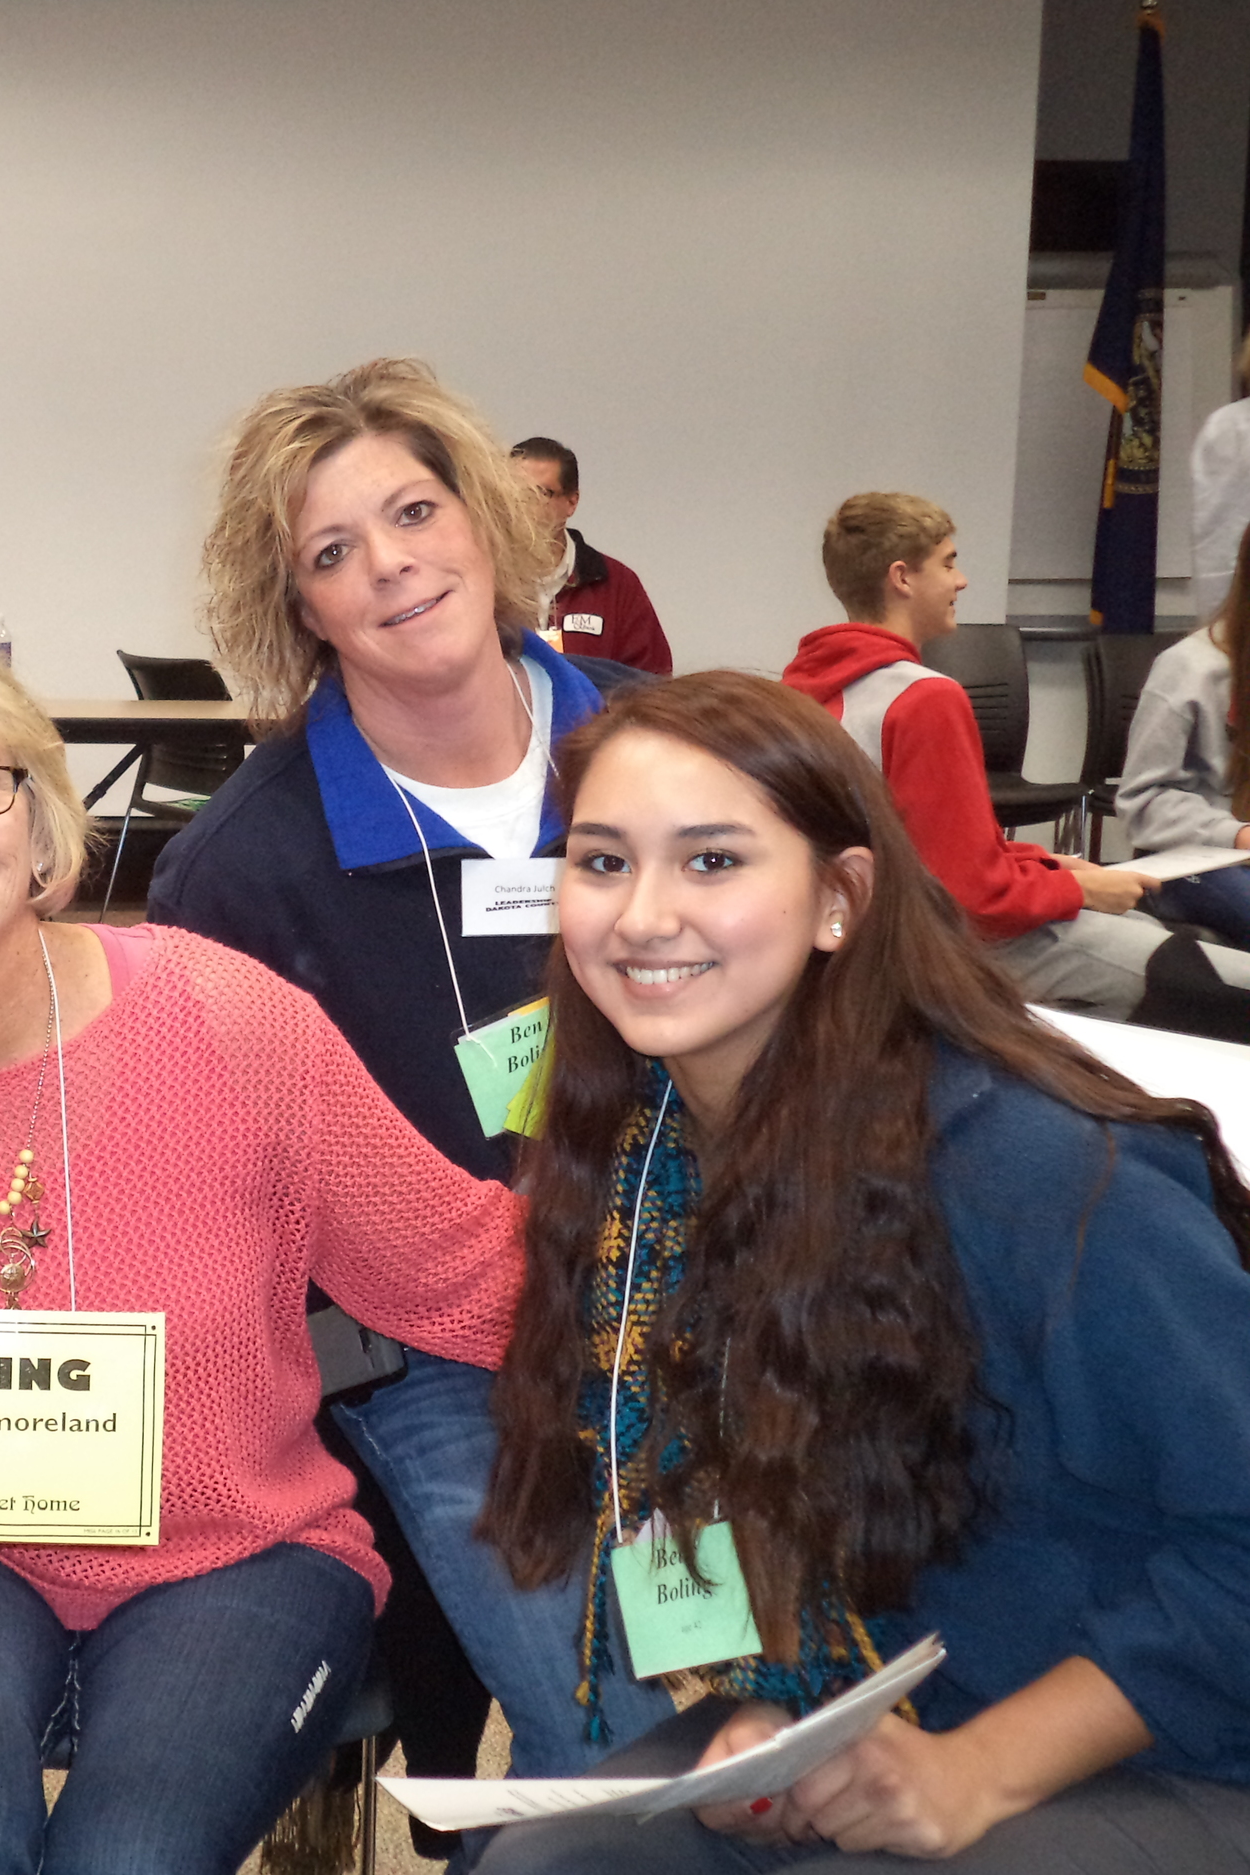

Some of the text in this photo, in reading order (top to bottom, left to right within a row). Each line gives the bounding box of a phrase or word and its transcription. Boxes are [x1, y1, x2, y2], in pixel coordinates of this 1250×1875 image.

[494, 885, 532, 893] Chandra
[510, 1021, 542, 1044] Ben
[507, 1045, 541, 1073] Boli
[22, 1495, 81, 1515] Home
